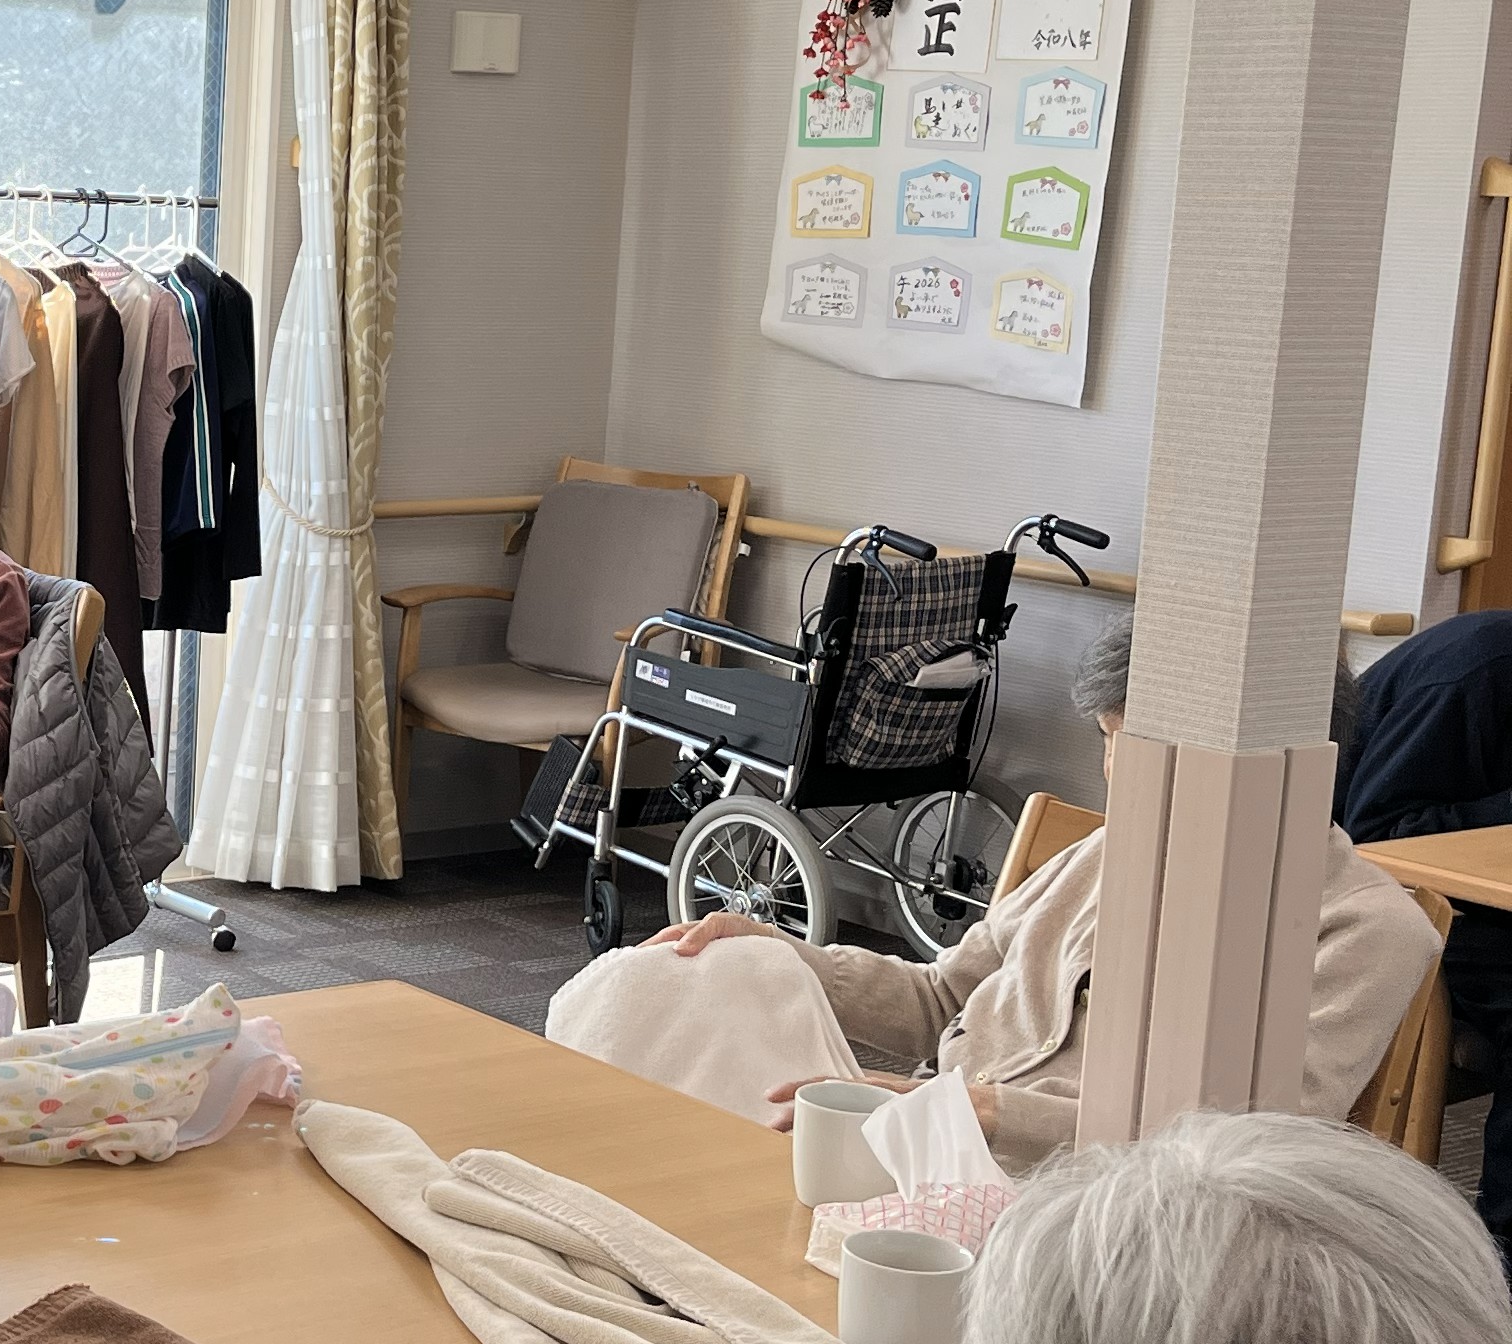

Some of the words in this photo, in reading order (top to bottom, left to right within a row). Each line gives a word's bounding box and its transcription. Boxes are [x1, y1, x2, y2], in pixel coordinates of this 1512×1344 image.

[1032, 29, 1092, 51] 令和八年
[914, 278, 941, 288] 2026
